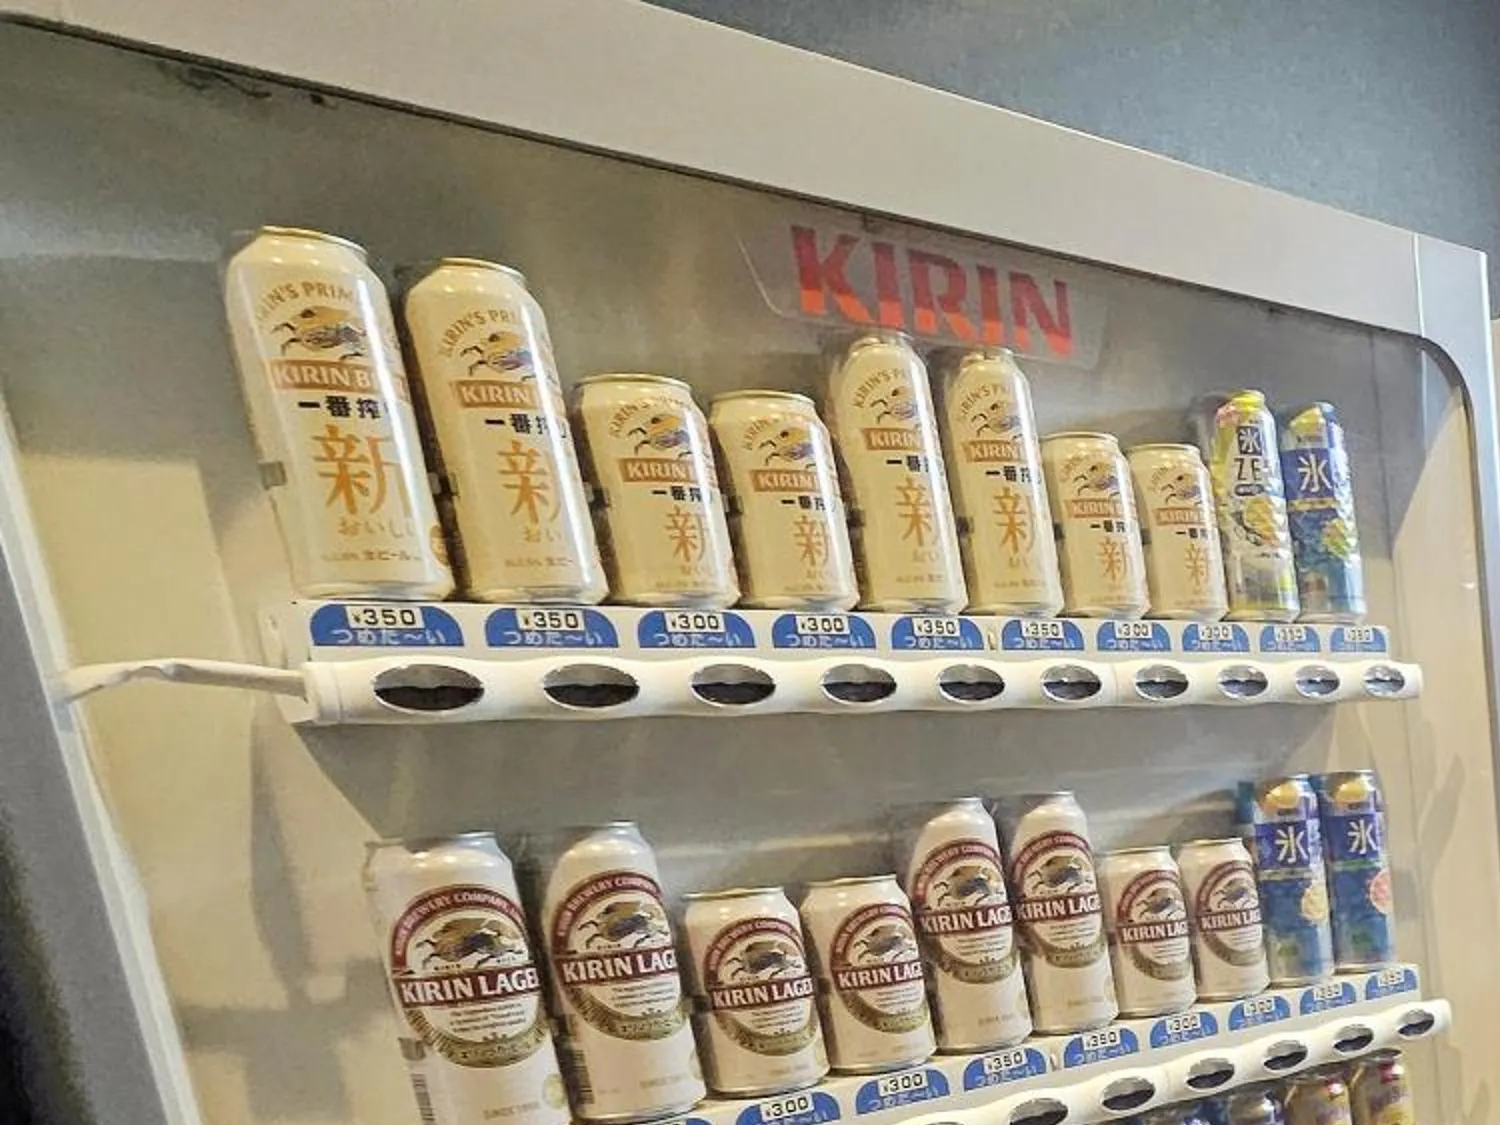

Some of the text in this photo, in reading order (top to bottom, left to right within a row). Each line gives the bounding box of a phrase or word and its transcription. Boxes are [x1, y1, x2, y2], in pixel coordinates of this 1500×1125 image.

[793, 225, 1073, 356] KIRIN
[274, 365, 349, 387] KIRIN
[461, 385, 531, 405] KIRIN
[311, 423, 410, 516] 新
[626, 462, 687, 479] KIRIN
[1298, 453, 1332, 493] 氷
[352, 607, 417, 626] ¥350
[523, 611, 579, 629] ¥350
[671, 615, 720, 630] ¥300
[800, 617, 844, 632] ¥300
[1275, 826, 1309, 864] 氷
[1347, 819, 1379, 855] 氷
[1016, 901, 1067, 921] KIRIN
[922, 914, 976, 933] KIRIN
[1122, 925, 1166, 942] KIRIN
[562, 955, 633, 983] KIRIN
[838, 967, 892, 989] KIRIN
[401, 977, 474, 1004] KIRIN
[713, 985, 770, 1008] KIRIN
[766, 1096, 808, 1116] ¥300
